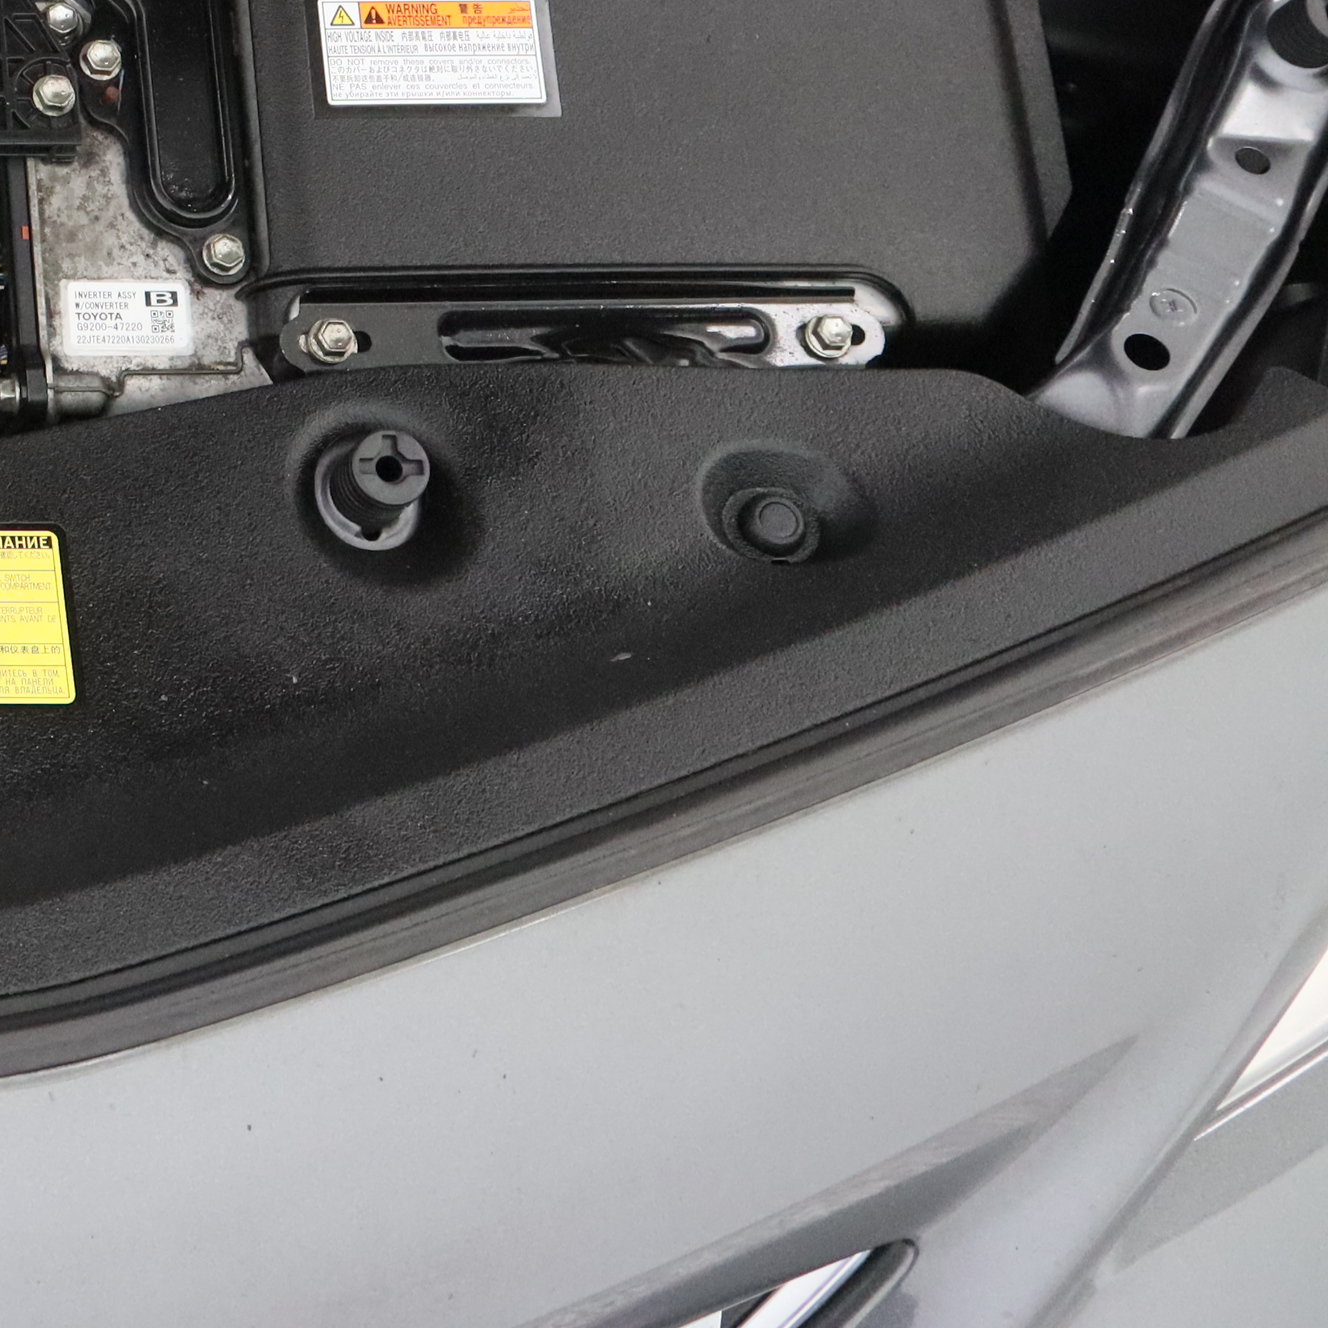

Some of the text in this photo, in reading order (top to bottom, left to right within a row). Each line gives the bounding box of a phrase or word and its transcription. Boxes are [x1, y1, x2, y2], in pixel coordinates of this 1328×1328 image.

[385, 3, 437, 13] WARNING
[386, 15, 451, 25] AVERTISSEMENT
[326, 31, 394, 42] HIGH VOLTAGE INSIDE
[328, 44, 348, 54] HAUTE
[349, 44, 375, 54] TENSION
[424, 43, 534, 54] высокое напряжение внутри
[371, 82, 401, 90] enlever
[74, 290, 137, 300] INVERTER ASSY
[150, 291, 174, 307] B
[74, 301, 129, 310] W/CONVERTER
[75, 312, 123, 321] TOYOTA
[76, 322, 143, 332] G9200-47220
